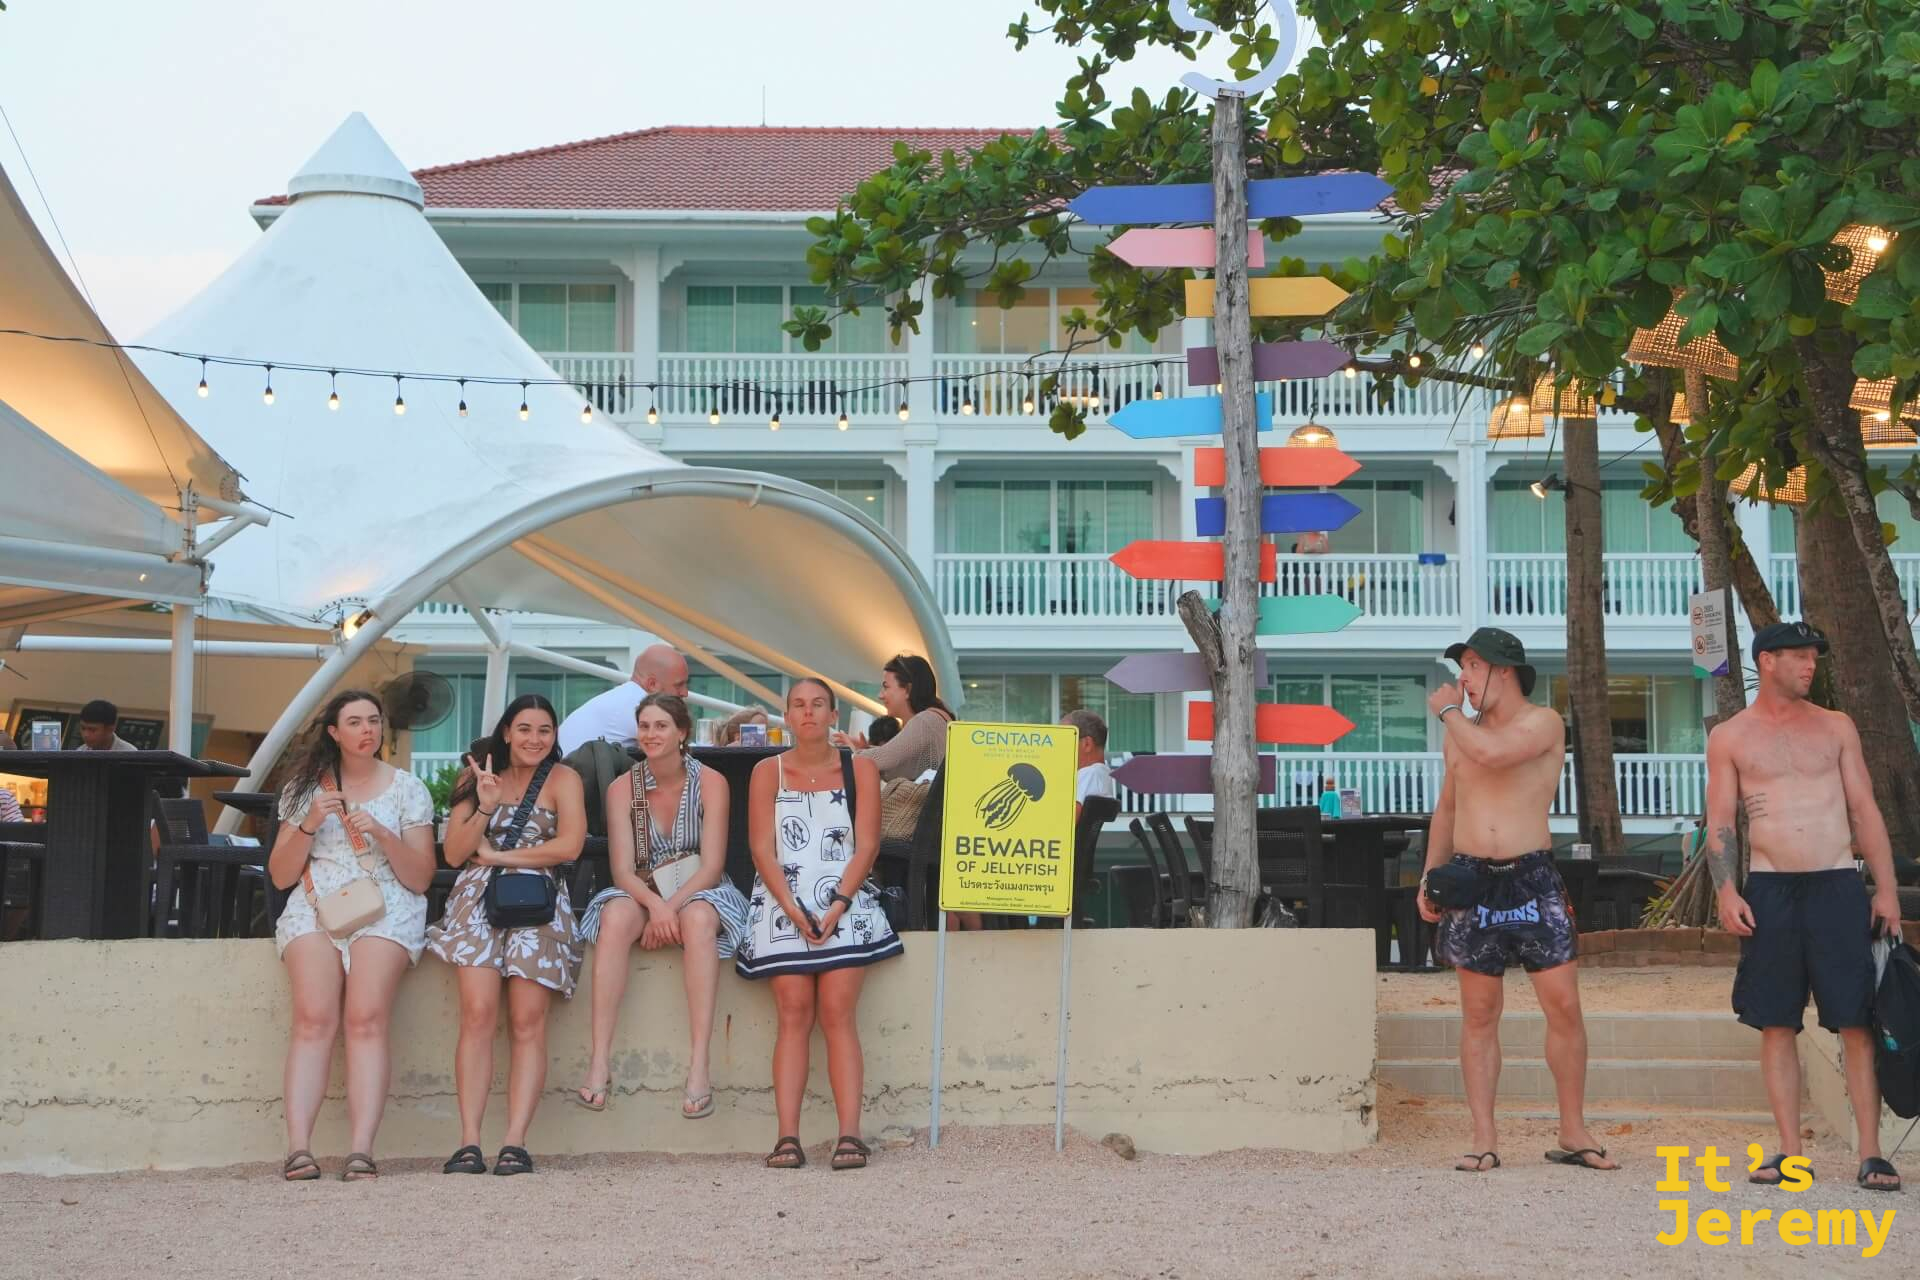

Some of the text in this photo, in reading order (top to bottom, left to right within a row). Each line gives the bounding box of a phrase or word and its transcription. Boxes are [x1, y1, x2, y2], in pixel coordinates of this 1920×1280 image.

[971, 730, 1053, 746] CENTARA
[634, 770, 643, 799] COUNTRY
[956, 836, 1061, 859] BEWARE
[957, 861, 1058, 876] OF JELLYFISH
[959, 877, 1054, 895] โปรดระวังแมงกะพรุน
[1477, 898, 1540, 929] TWINS
